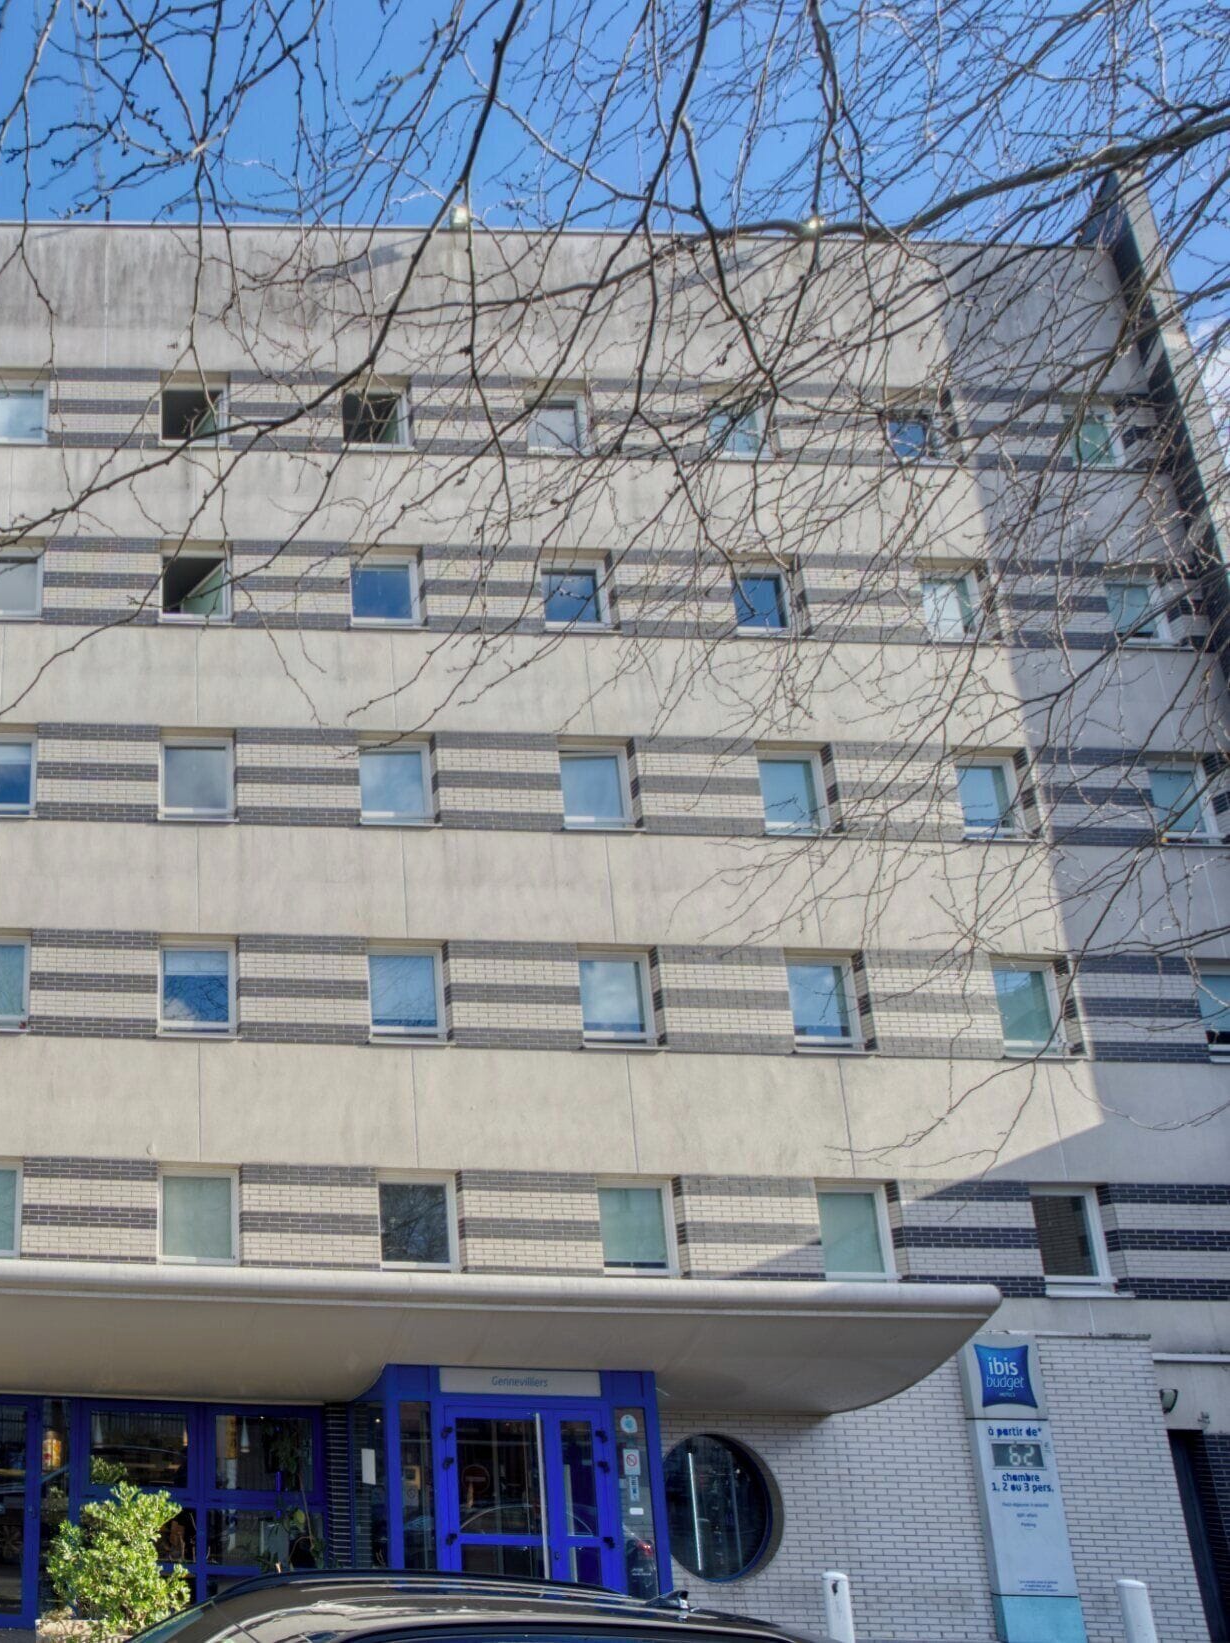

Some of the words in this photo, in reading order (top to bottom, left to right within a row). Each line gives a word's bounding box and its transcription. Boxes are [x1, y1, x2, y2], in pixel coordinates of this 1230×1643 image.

[988, 1356, 1019, 1376] ibis
[986, 1375, 1025, 1391] budget
[987, 1425, 995, 1436] à
[996, 1426, 1023, 1438] partir
[1008, 1444, 1035, 1466] 62
[1001, 1473, 1040, 1482] chambre
[1002, 1482, 1009, 1491] 2
[1010, 1484, 1022, 1492] ou
[1023, 1482, 1030, 1492] 3
